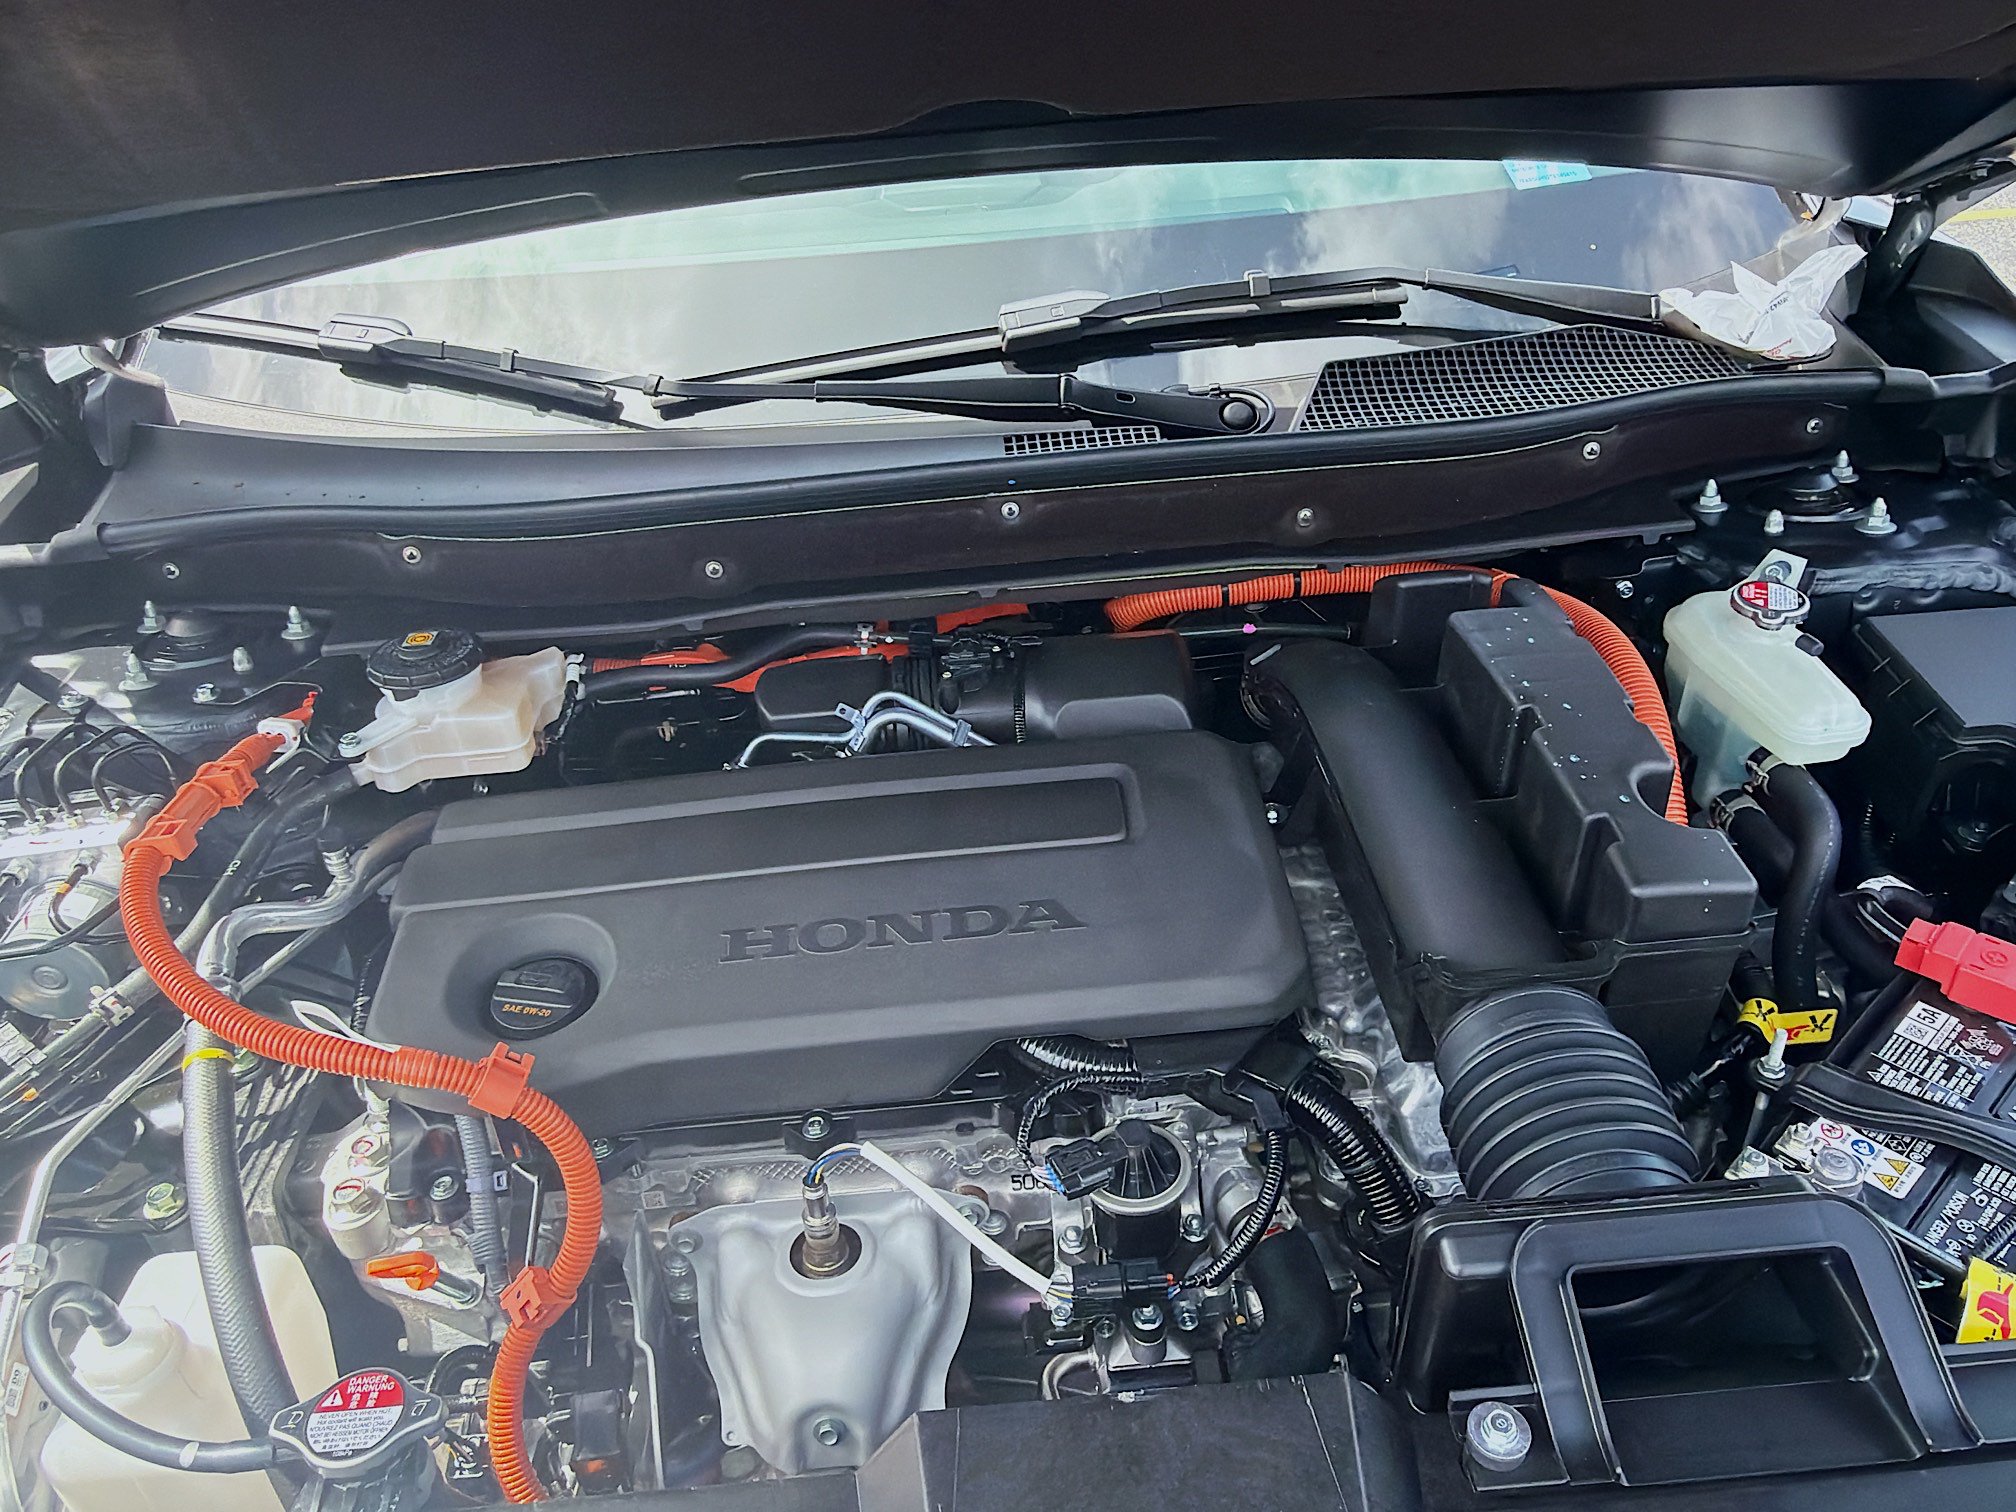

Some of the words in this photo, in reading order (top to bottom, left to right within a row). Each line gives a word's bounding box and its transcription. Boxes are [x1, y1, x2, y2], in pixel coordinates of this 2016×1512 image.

[719, 898, 1088, 964] HONDA
[502, 1004, 523, 1013] SAE
[1917, 1007, 1942, 1024] 5A
[1942, 1190, 1969, 1219] POISON
[347, 1381, 395, 1394] WARNUNG
[349, 1375, 389, 1385] DANGER
